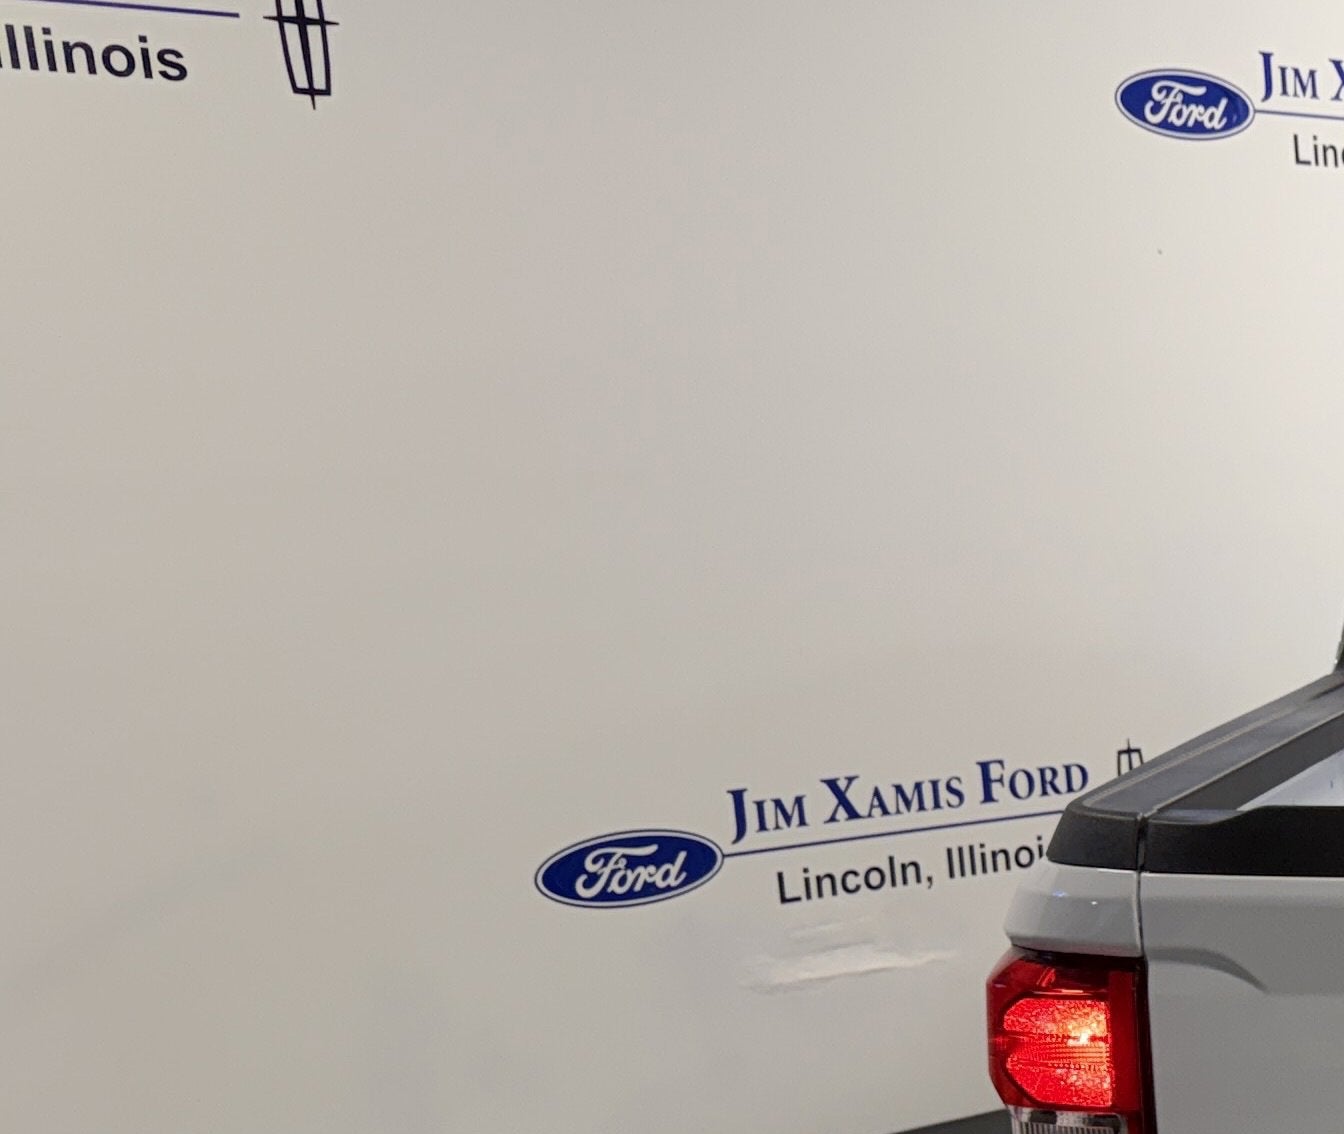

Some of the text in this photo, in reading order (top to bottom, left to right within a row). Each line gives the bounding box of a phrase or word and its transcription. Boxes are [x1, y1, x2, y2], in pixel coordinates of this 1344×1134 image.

[0, 23, 188, 82] llinois
[1258, 50, 1318, 102] JIM
[1144, 80, 1228, 131] Ford
[726, 759, 1090, 845] JIM XAMIS FORD
[574, 844, 688, 898] Ford
[777, 835, 1045, 905] Lincoln, Illinoi
